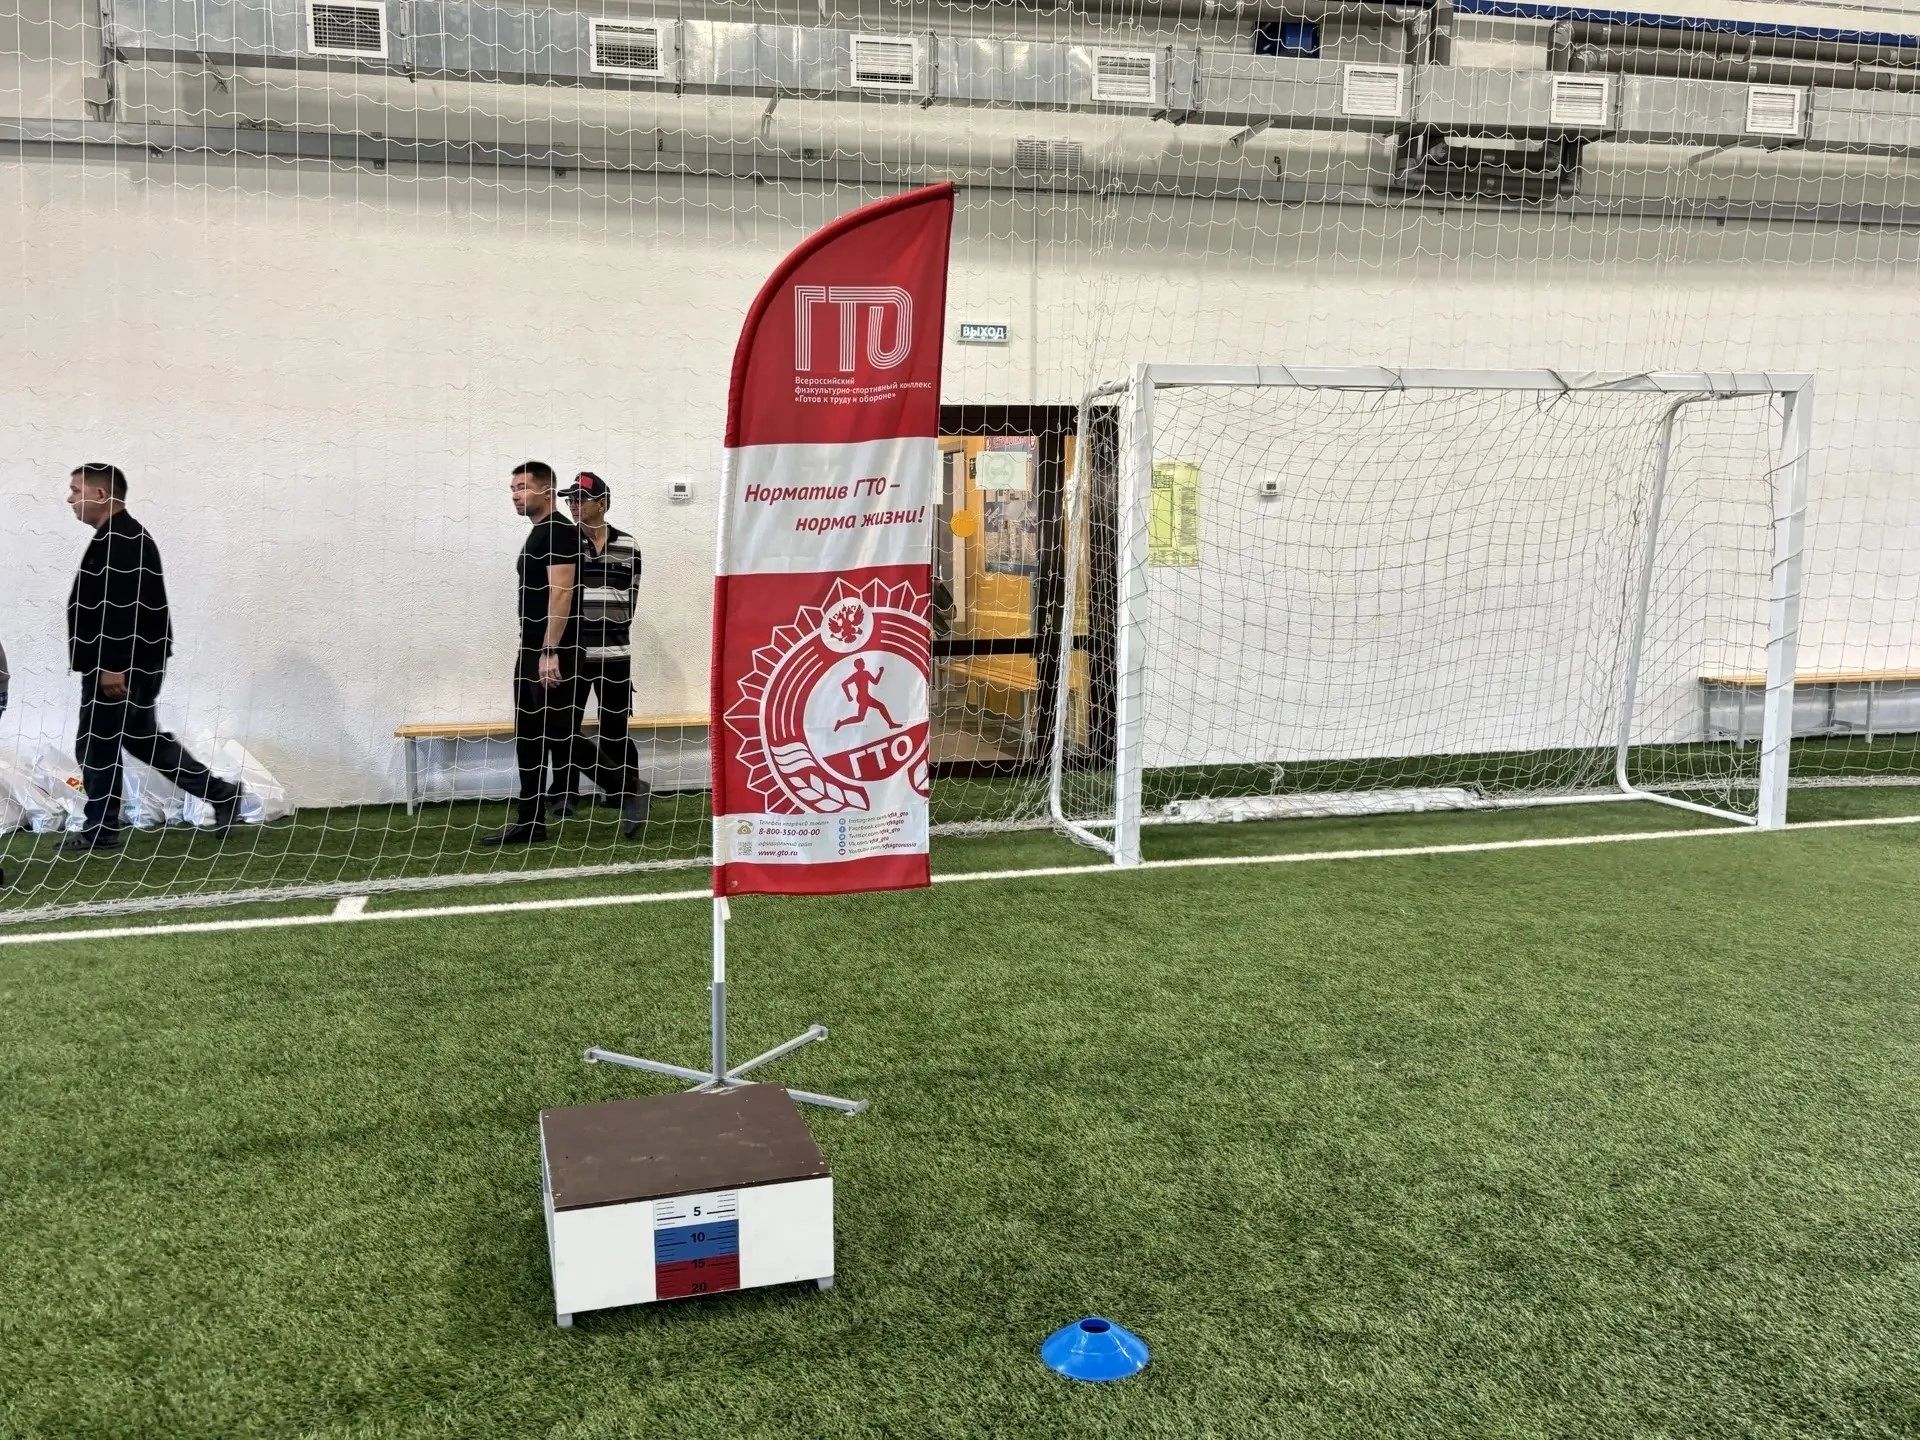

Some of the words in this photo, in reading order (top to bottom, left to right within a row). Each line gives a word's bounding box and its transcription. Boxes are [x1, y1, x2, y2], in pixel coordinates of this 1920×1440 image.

[795, 286, 913, 372] ГТО
[963, 326, 1005, 340] ВЫХОД
[795, 376, 855, 385] Всероссийский
[795, 382, 898, 395] физкультурно-спортивный
[795, 395, 822, 403] «Готов
[830, 396, 852, 405] труду
[859, 393, 897, 403] обороне»
[745, 484, 848, 505] Норматив
[854, 477, 886, 497] ГТО
[796, 514, 856, 535] норма
[861, 506, 925, 528] жизни!
[849, 735, 913, 779] ГТО
[758, 828, 821, 836] 8-800-350-00-00
[693, 1206, 701, 1216] 5
[690, 1232, 706, 1243] 10
[691, 1258, 706, 1269] 15
[691, 1282, 708, 1294] 20
